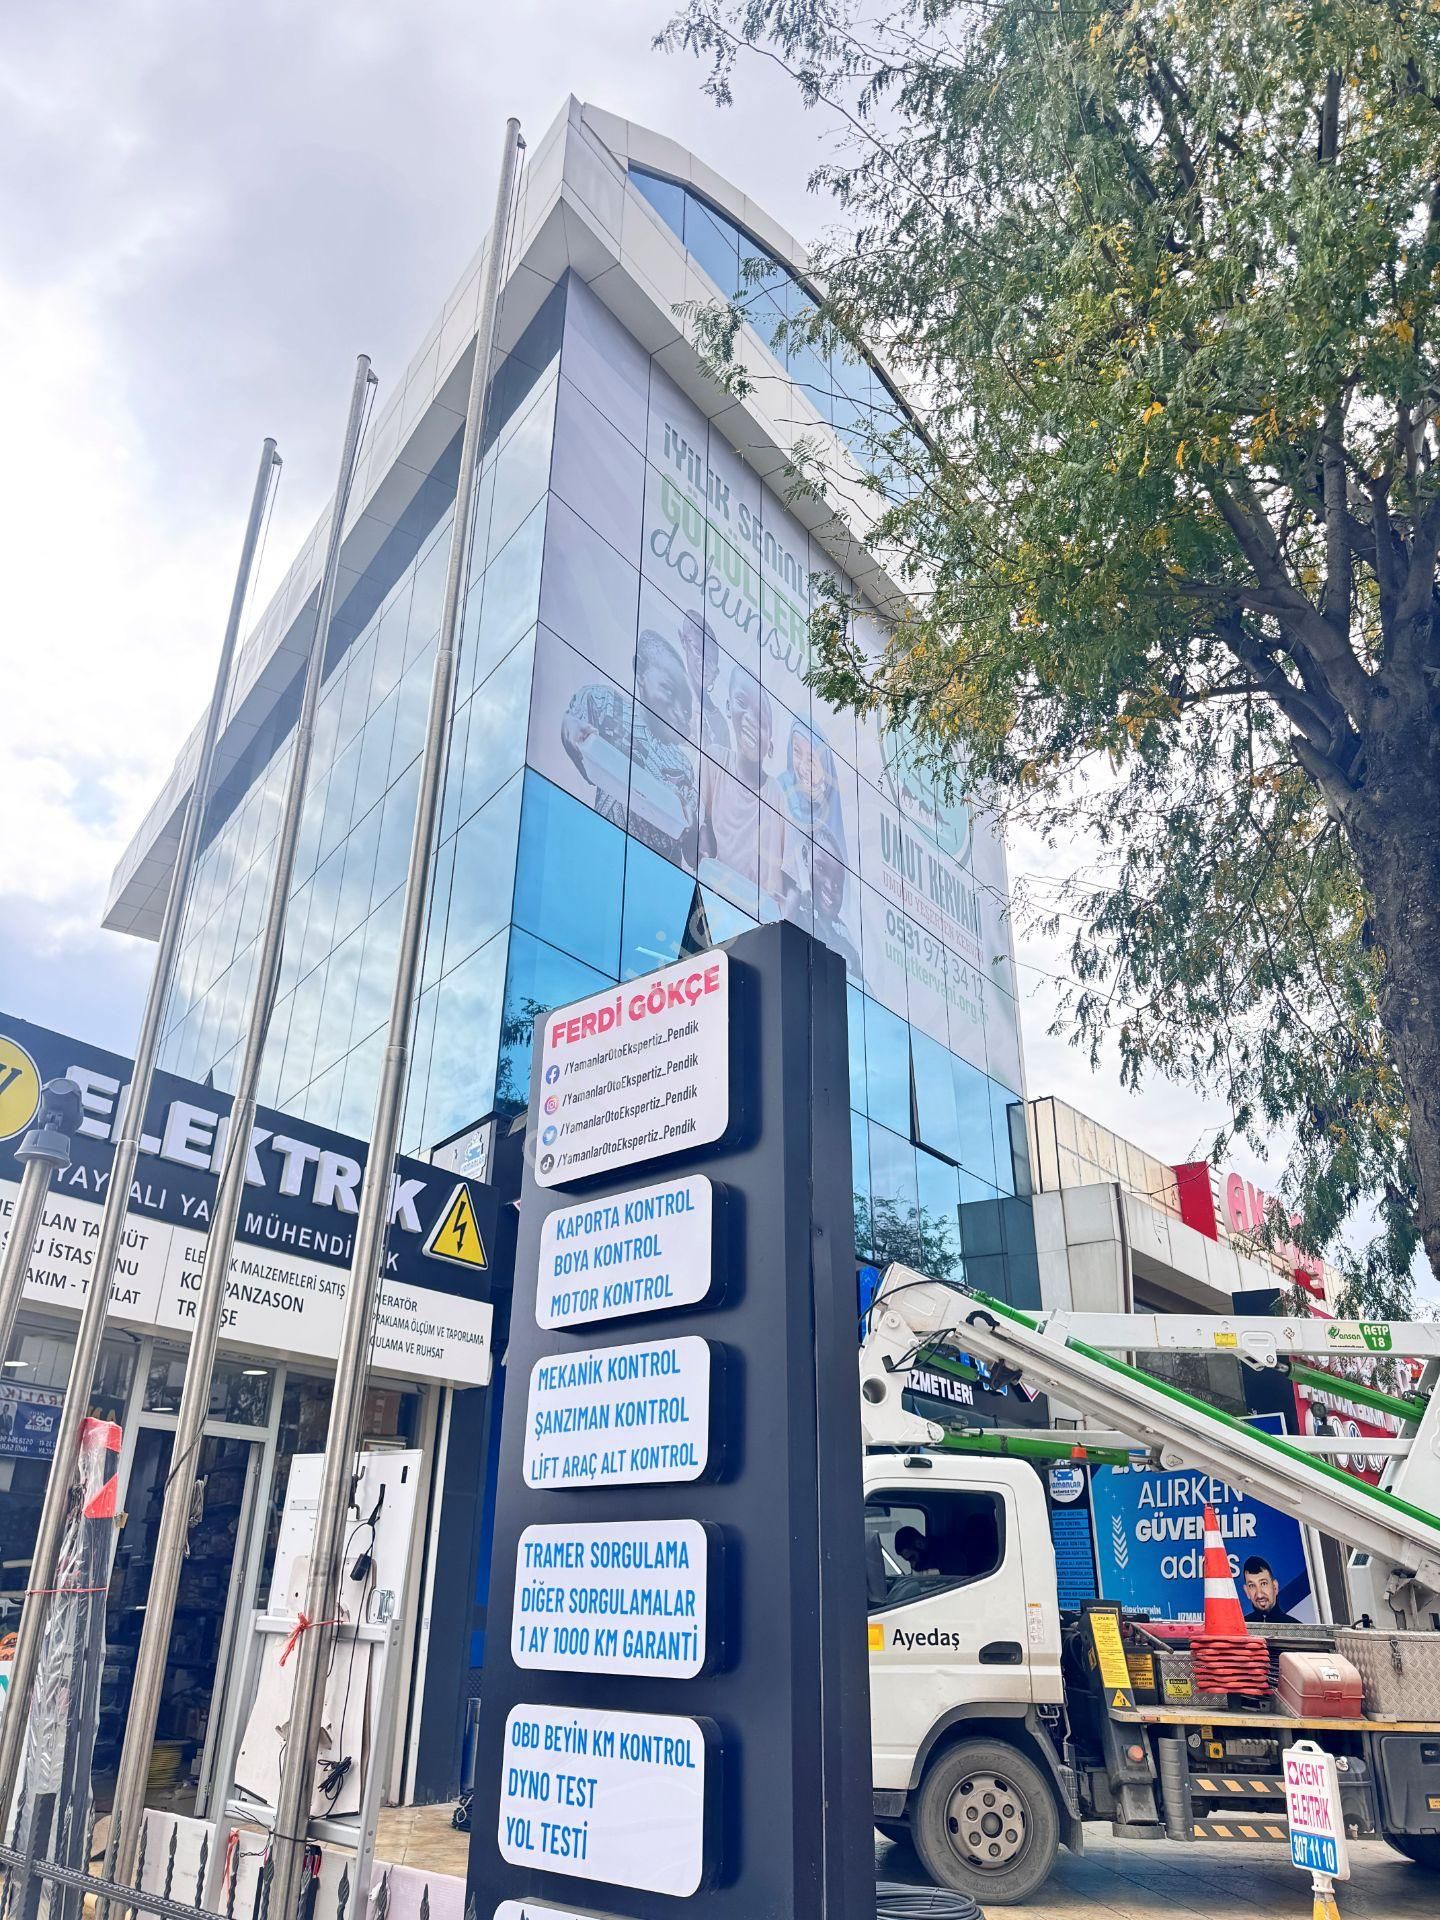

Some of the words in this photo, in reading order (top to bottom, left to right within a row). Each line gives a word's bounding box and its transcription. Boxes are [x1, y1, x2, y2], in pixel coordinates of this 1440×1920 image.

[880, 812, 923, 892] UMUT
[886, 908, 920, 956] 0531
[952, 958, 968, 991] 34
[551, 996, 623, 1049] FERDİ
[628, 964, 721, 1023] GÖKÇE
[57, 1163, 167, 1210] YAYALI
[556, 1206, 620, 1241] KAPORTA
[624, 1188, 695, 1225] KONTROL
[554, 1248, 589, 1277] BOYA
[593, 1234, 662, 1269] KONTROL
[26, 1267, 67, 1289] AKIM
[180, 1271, 304, 1314] KOPANZASON
[240, 1260, 317, 1291] MALZEMELERİ
[318, 1279, 346, 1299] SATIŞ
[550, 1287, 599, 1318] MOTOR
[602, 1273, 674, 1309] KONTROL
[405, 1342, 415, 1354] VE
[416, 1344, 444, 1359] RUHSAT
[436, 1327, 445, 1338] VE
[1371, 1336, 1386, 1348] 18
[537, 1354, 603, 1392] MEKANİK
[607, 1348, 681, 1383] KONTROL
[534, 1403, 610, 1441] ŞANZIMAN
[614, 1396, 690, 1429] KONTROL
[531, 1453, 560, 1481] LİFT
[562, 1453, 598, 1480] ARAÇ
[601, 1449, 627, 1474] ALT
[630, 1442, 699, 1471] KONTROL
[525, 1542, 584, 1569] TRAMER
[590, 1541, 690, 1569] SORGULAMA
[1160, 1548, 1241, 1579] adrs
[521, 1579, 565, 1613] DİĞER
[569, 1588, 696, 1617] SORGULAMALAR
[519, 1625, 526, 1653] 1
[528, 1626, 549, 1653] AY
[553, 1627, 590, 1656] 1000
[594, 1628, 618, 1657] KM
[623, 1624, 698, 1662] GARANTİ
[892, 1628, 960, 1652] Ayedaş
[512, 1721, 540, 1749] OBD
[544, 1720, 588, 1755] BEYİN
[592, 1730, 615, 1759] KM
[619, 1732, 696, 1769] KONTROL
[508, 1767, 550, 1802] DYNO
[556, 1774, 598, 1809] TEST
[1298, 1763, 1325, 1787] KENT
[506, 1816, 535, 1850] YOL
[541, 1821, 588, 1860] TESTİ
[1293, 1835, 1308, 1864] 307
[1310, 1838, 1321, 1867] 11
[1322, 1840, 1335, 1871] 10
